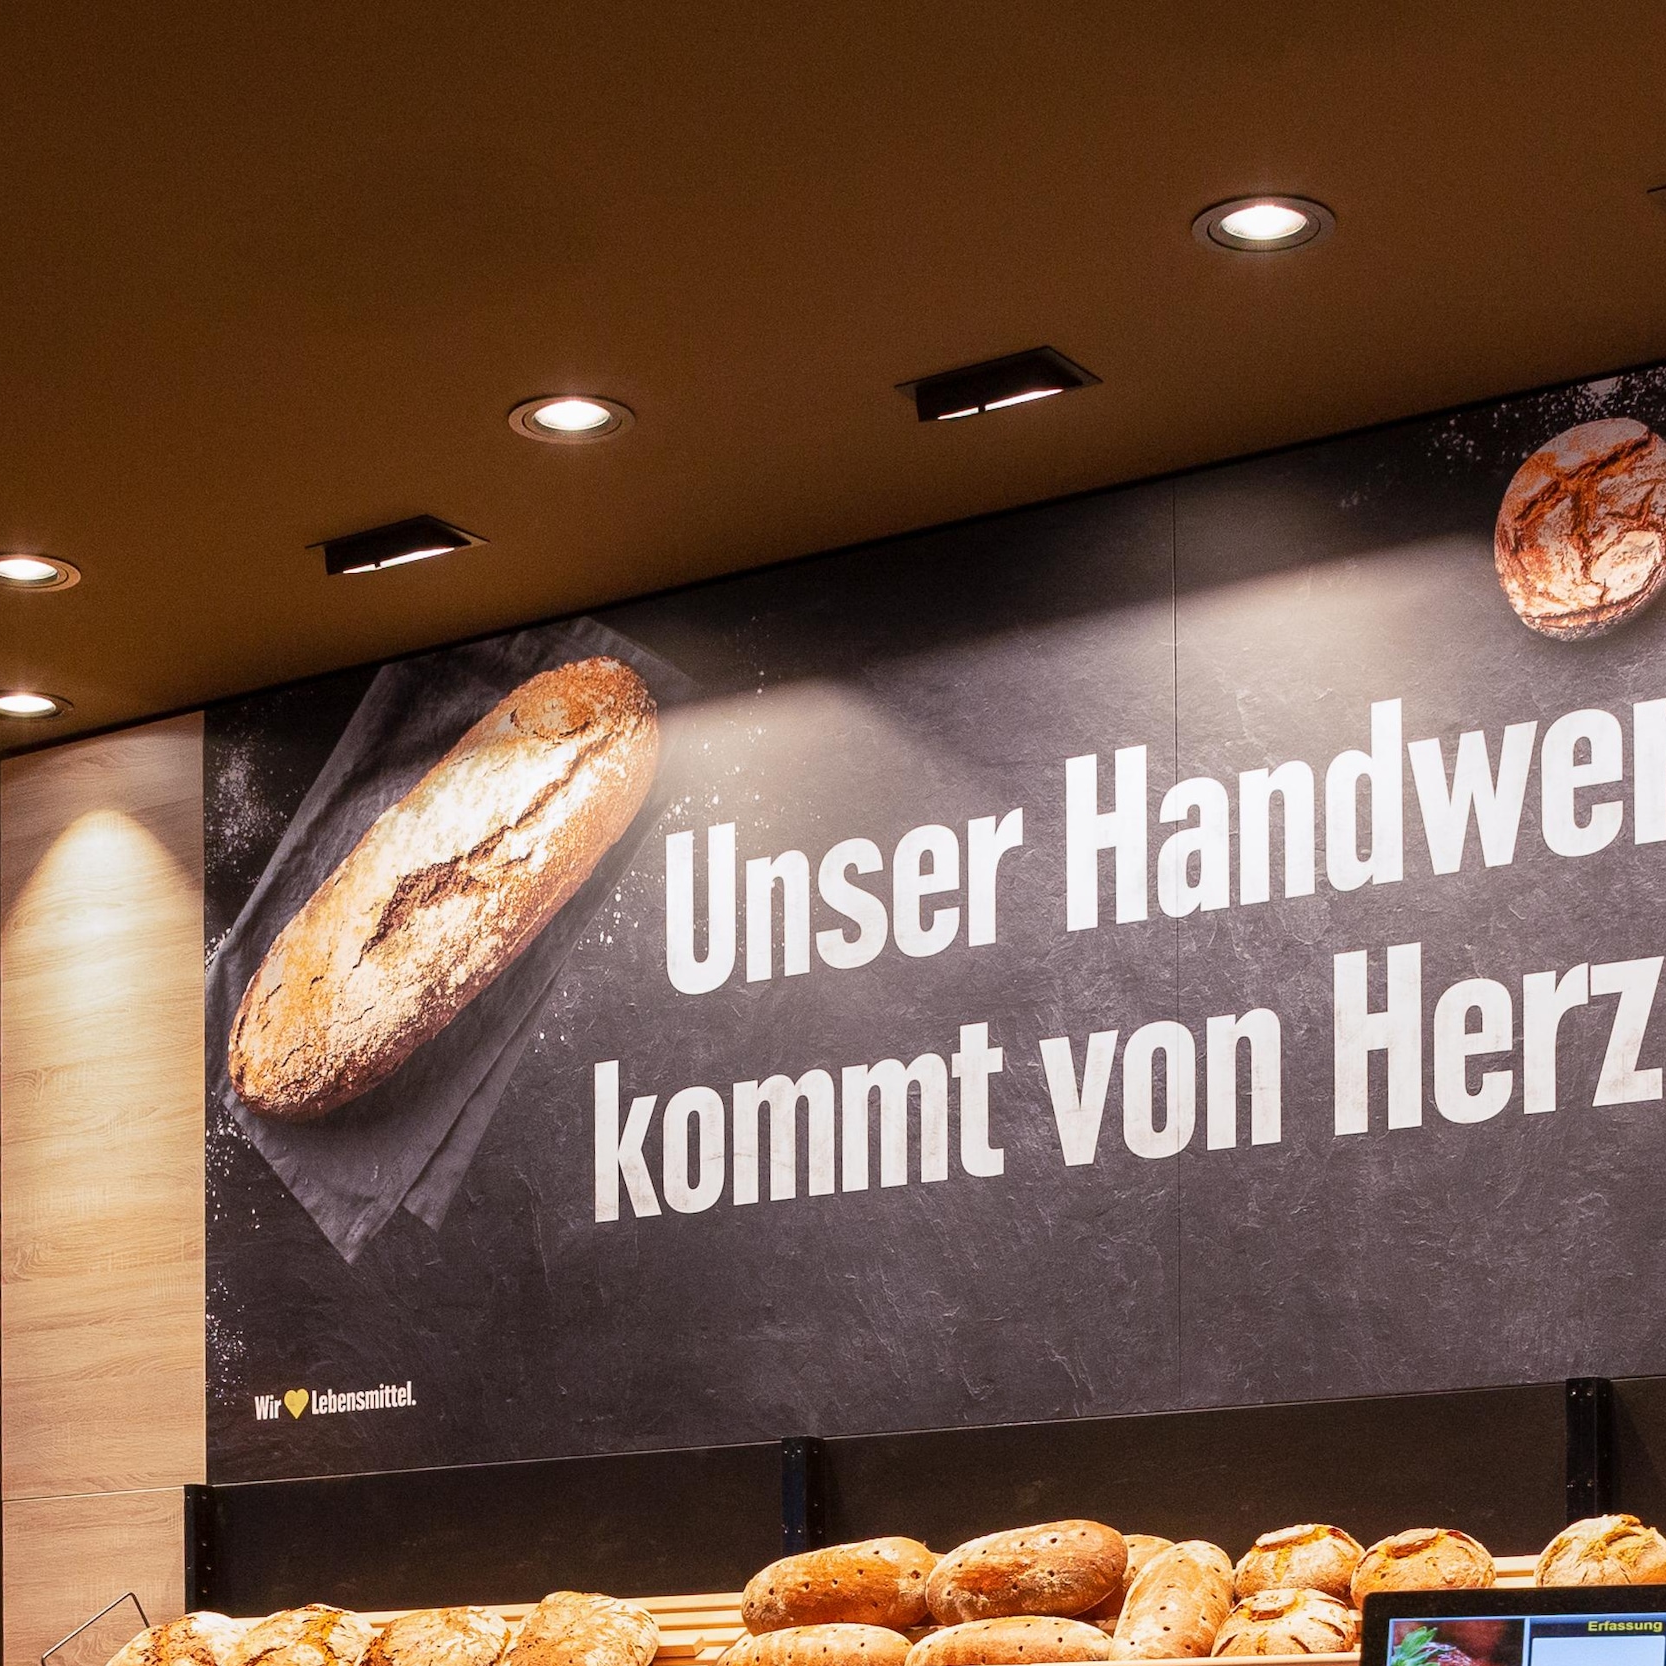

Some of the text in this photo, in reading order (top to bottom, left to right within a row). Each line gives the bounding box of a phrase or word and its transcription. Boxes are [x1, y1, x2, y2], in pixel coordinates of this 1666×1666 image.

[665, 806, 1024, 995] Unser
[594, 1021, 1006, 1223] kommt
[1038, 1007, 1282, 1167] von
[253, 1380, 417, 1421] Wir Lebensmittel.
[1587, 1619, 1664, 1634] Erfassung
